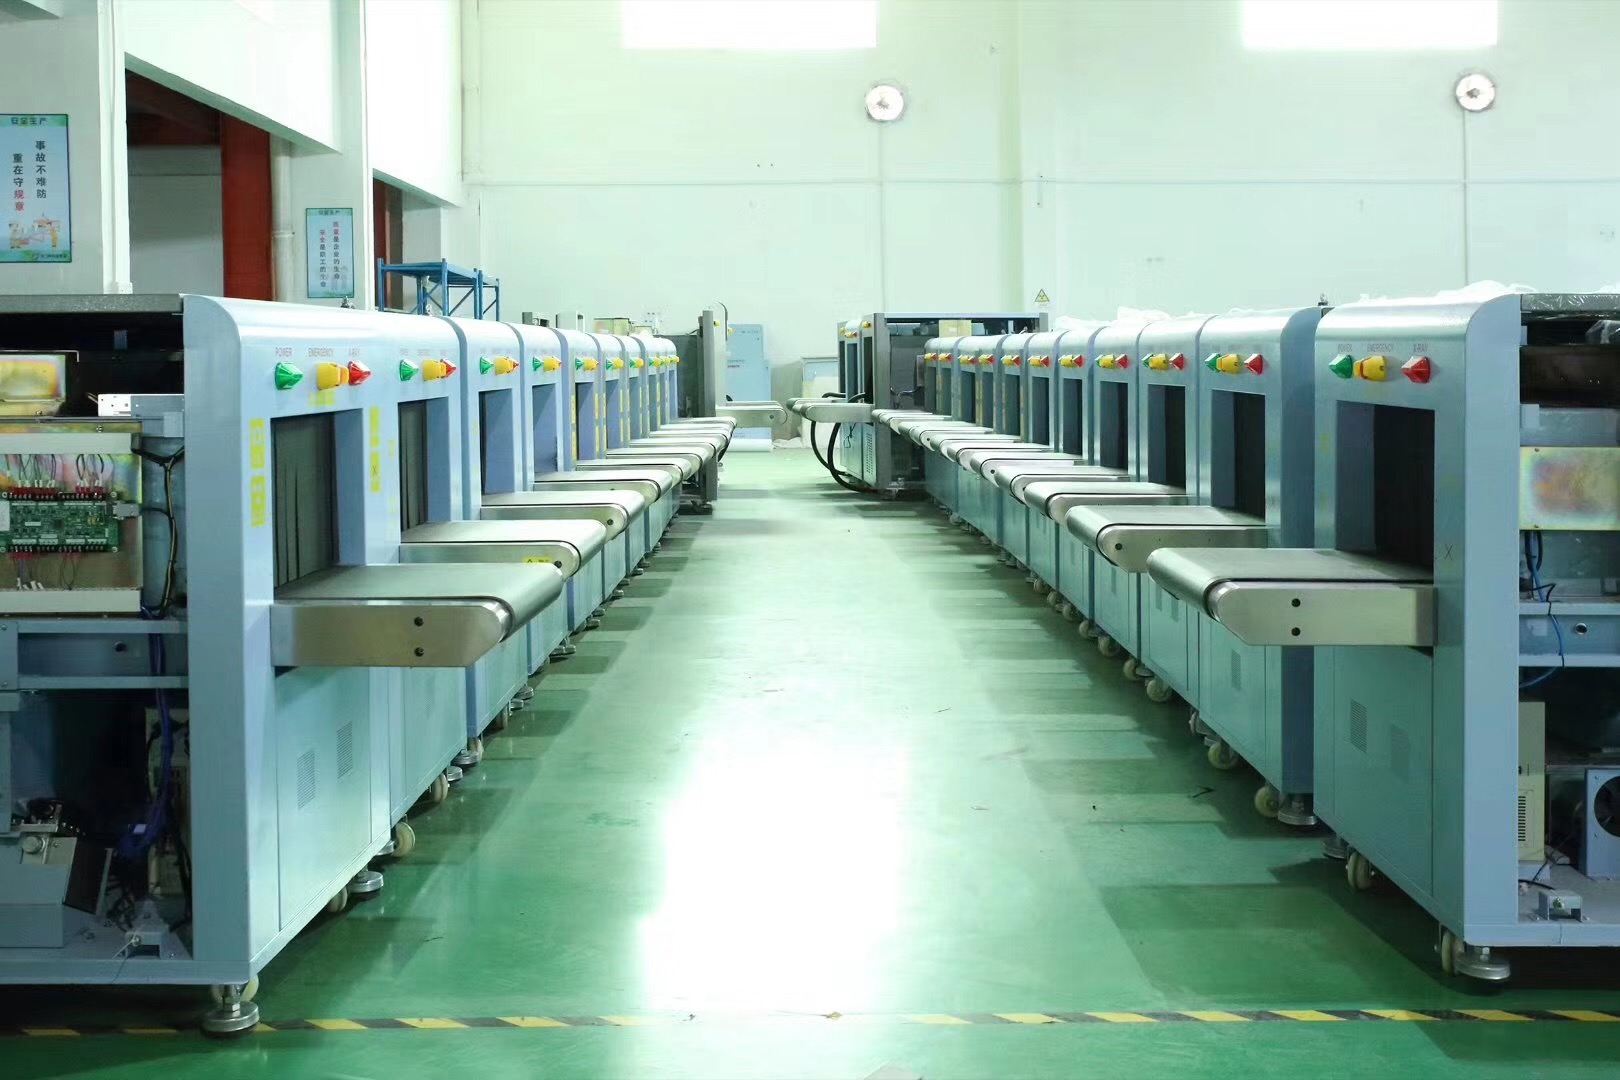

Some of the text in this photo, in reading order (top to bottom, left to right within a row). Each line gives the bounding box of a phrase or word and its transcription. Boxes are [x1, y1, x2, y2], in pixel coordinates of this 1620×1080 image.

[13, 153, 24, 211] 重在守规章
[35, 140, 46, 199] 事故不难防
[1366, 343, 1394, 353] EMERGENCY
